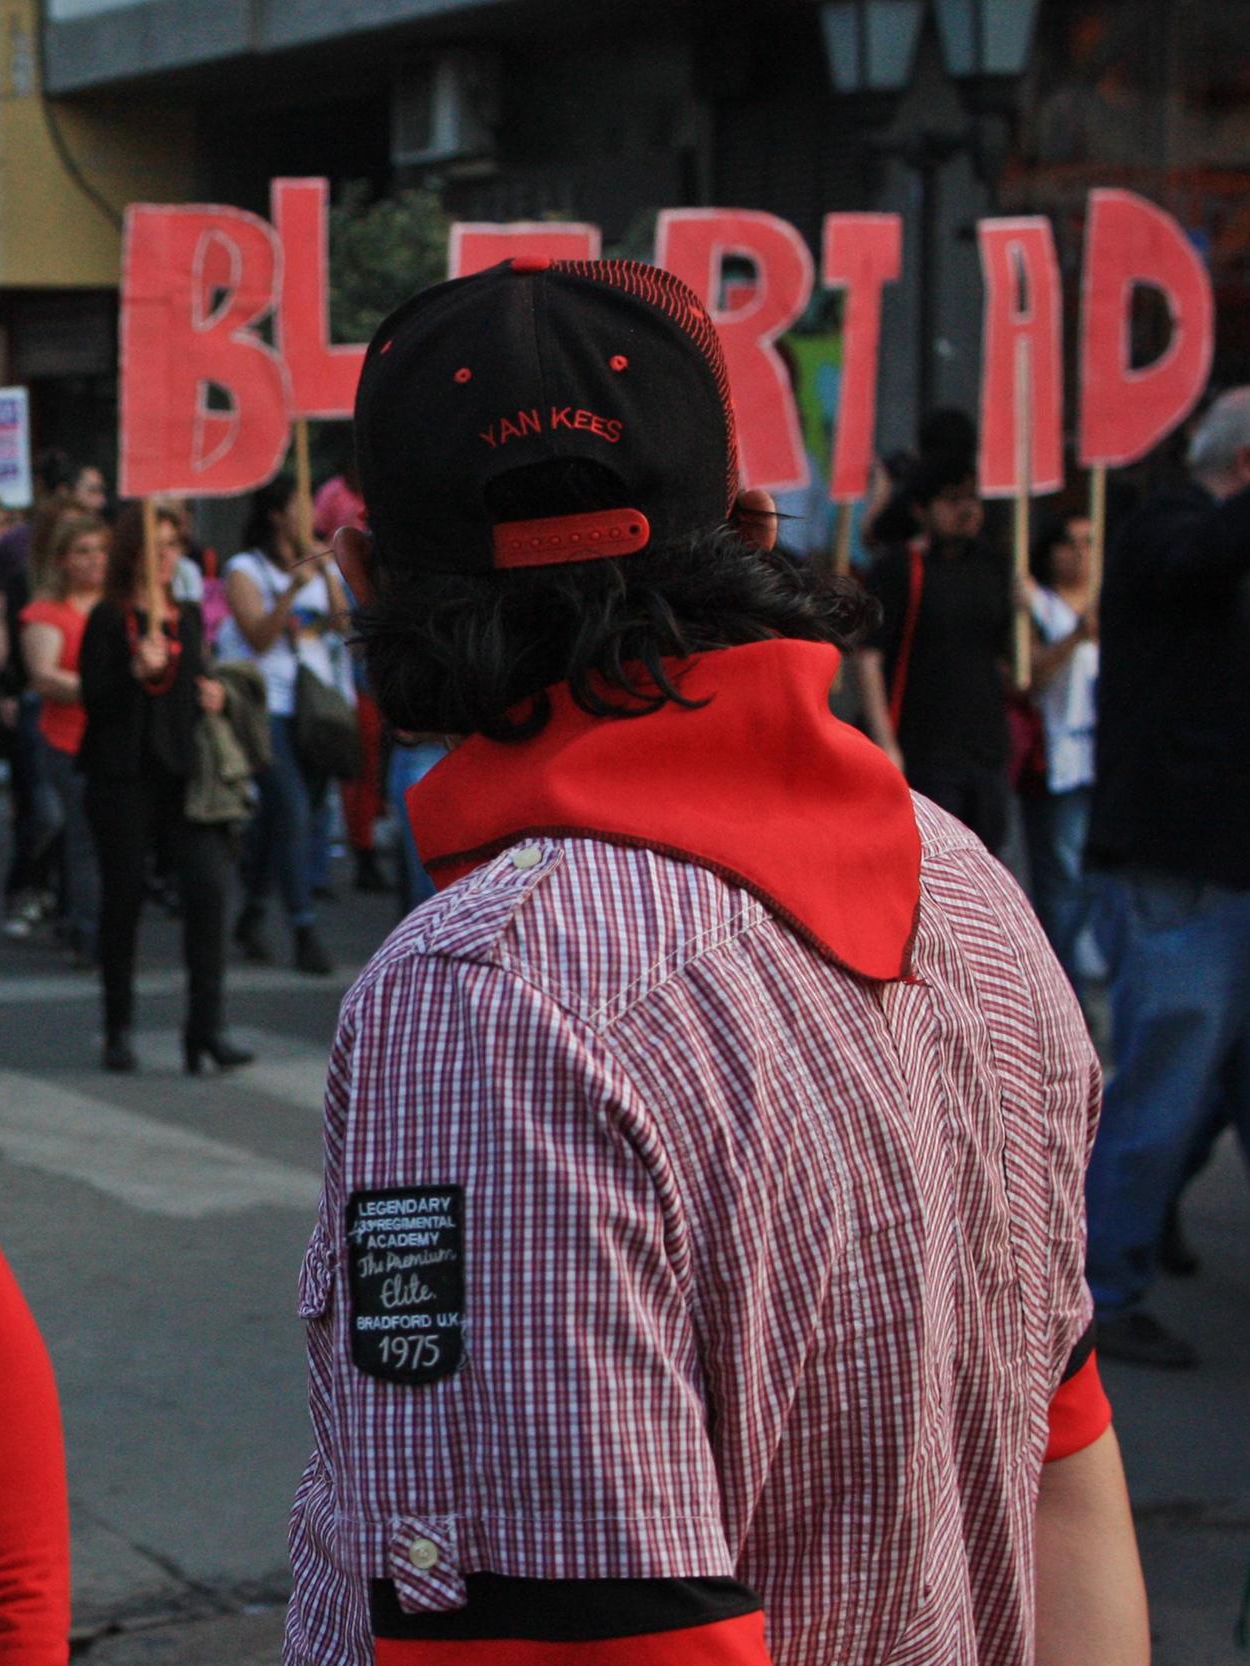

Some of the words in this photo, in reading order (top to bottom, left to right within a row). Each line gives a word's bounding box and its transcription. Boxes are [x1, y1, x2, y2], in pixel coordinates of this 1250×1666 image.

[358, 1197, 451, 1216] LEGENDARY
[367, 1231, 439, 1250] ACADEMY
[358, 1252, 384, 1278] The
[386, 1249, 457, 1272] Premium
[356, 1314, 431, 1330] BRADFORD
[378, 1335, 440, 1369] 1975
